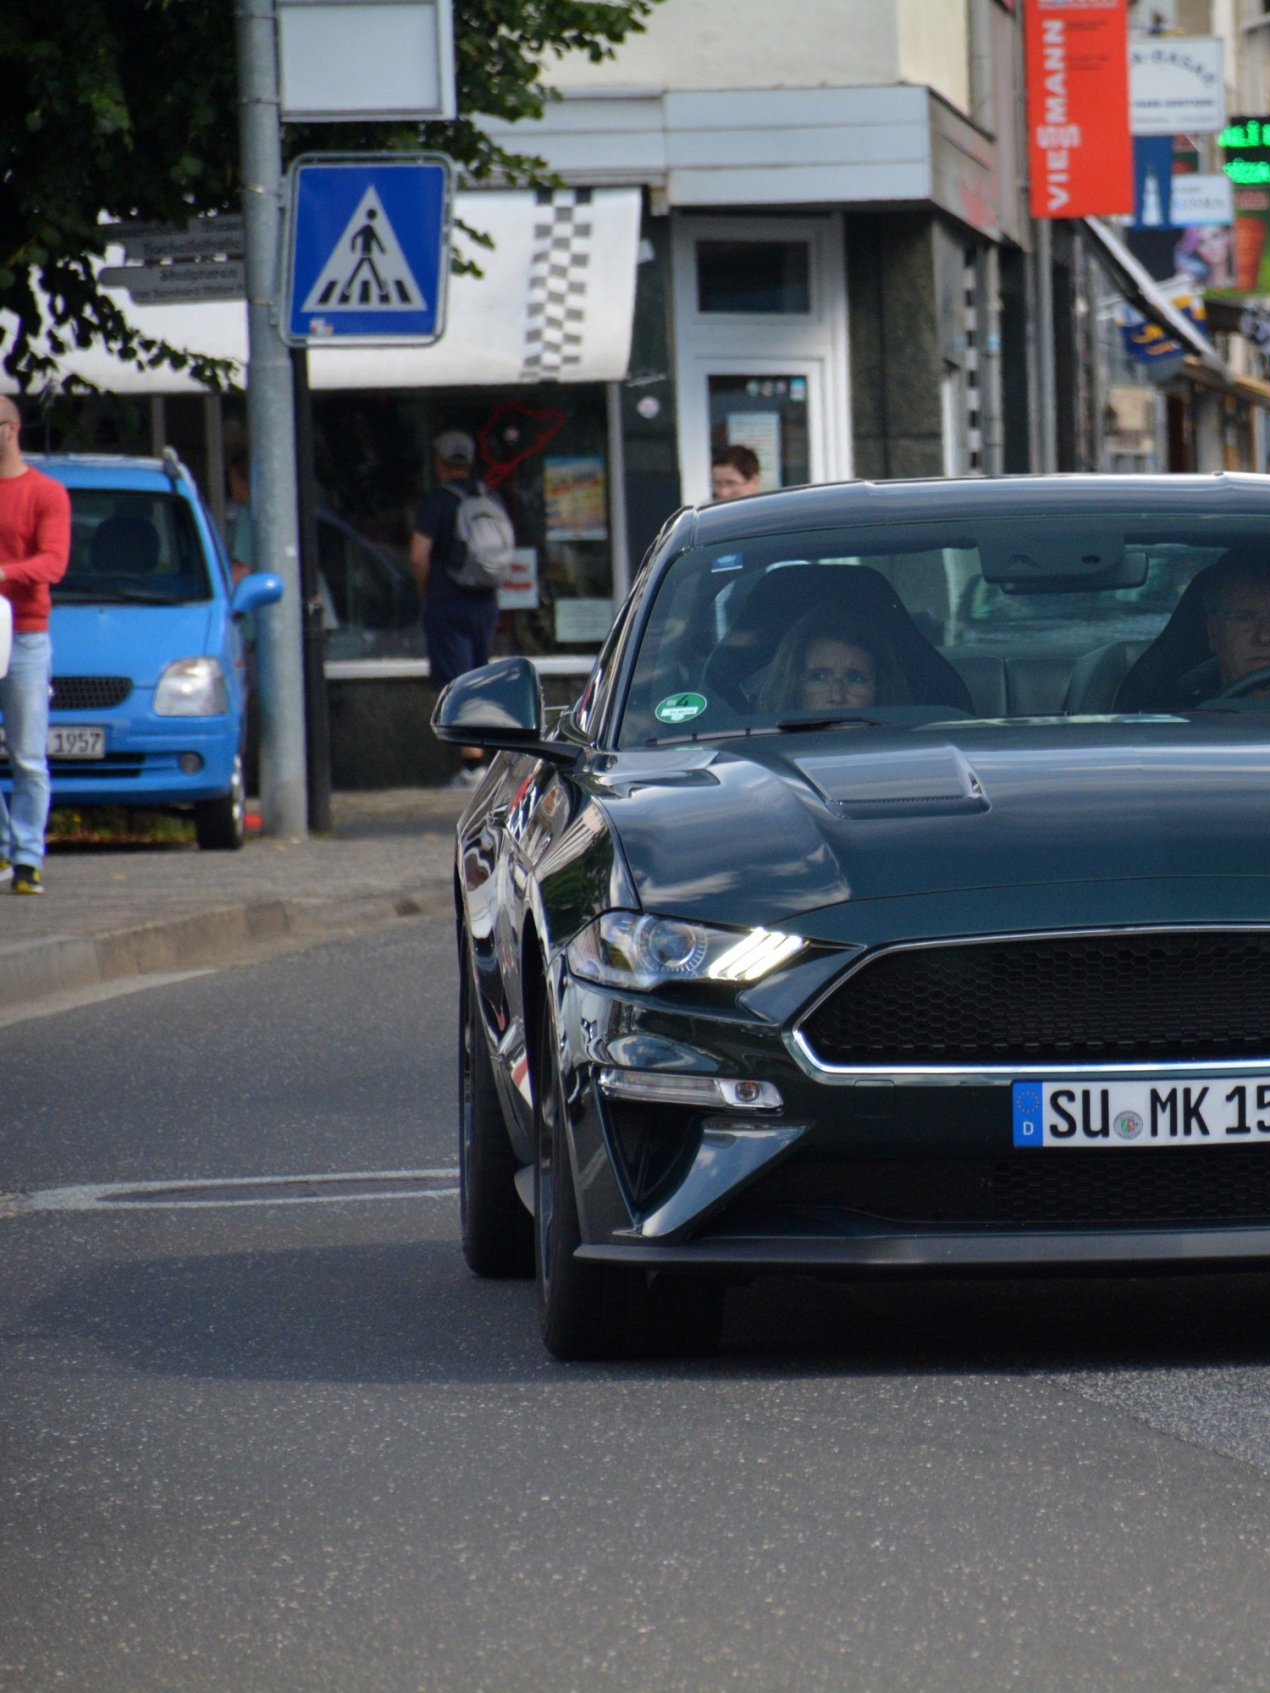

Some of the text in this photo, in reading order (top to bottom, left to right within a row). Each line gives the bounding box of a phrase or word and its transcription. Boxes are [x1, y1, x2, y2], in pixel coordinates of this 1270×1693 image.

[1037, 19, 1082, 211] VIESSMANN
[54, 732, 101, 753] 1957
[1049, 1089, 1110, 1139] SU
[1150, 1086, 1210, 1137] MK
